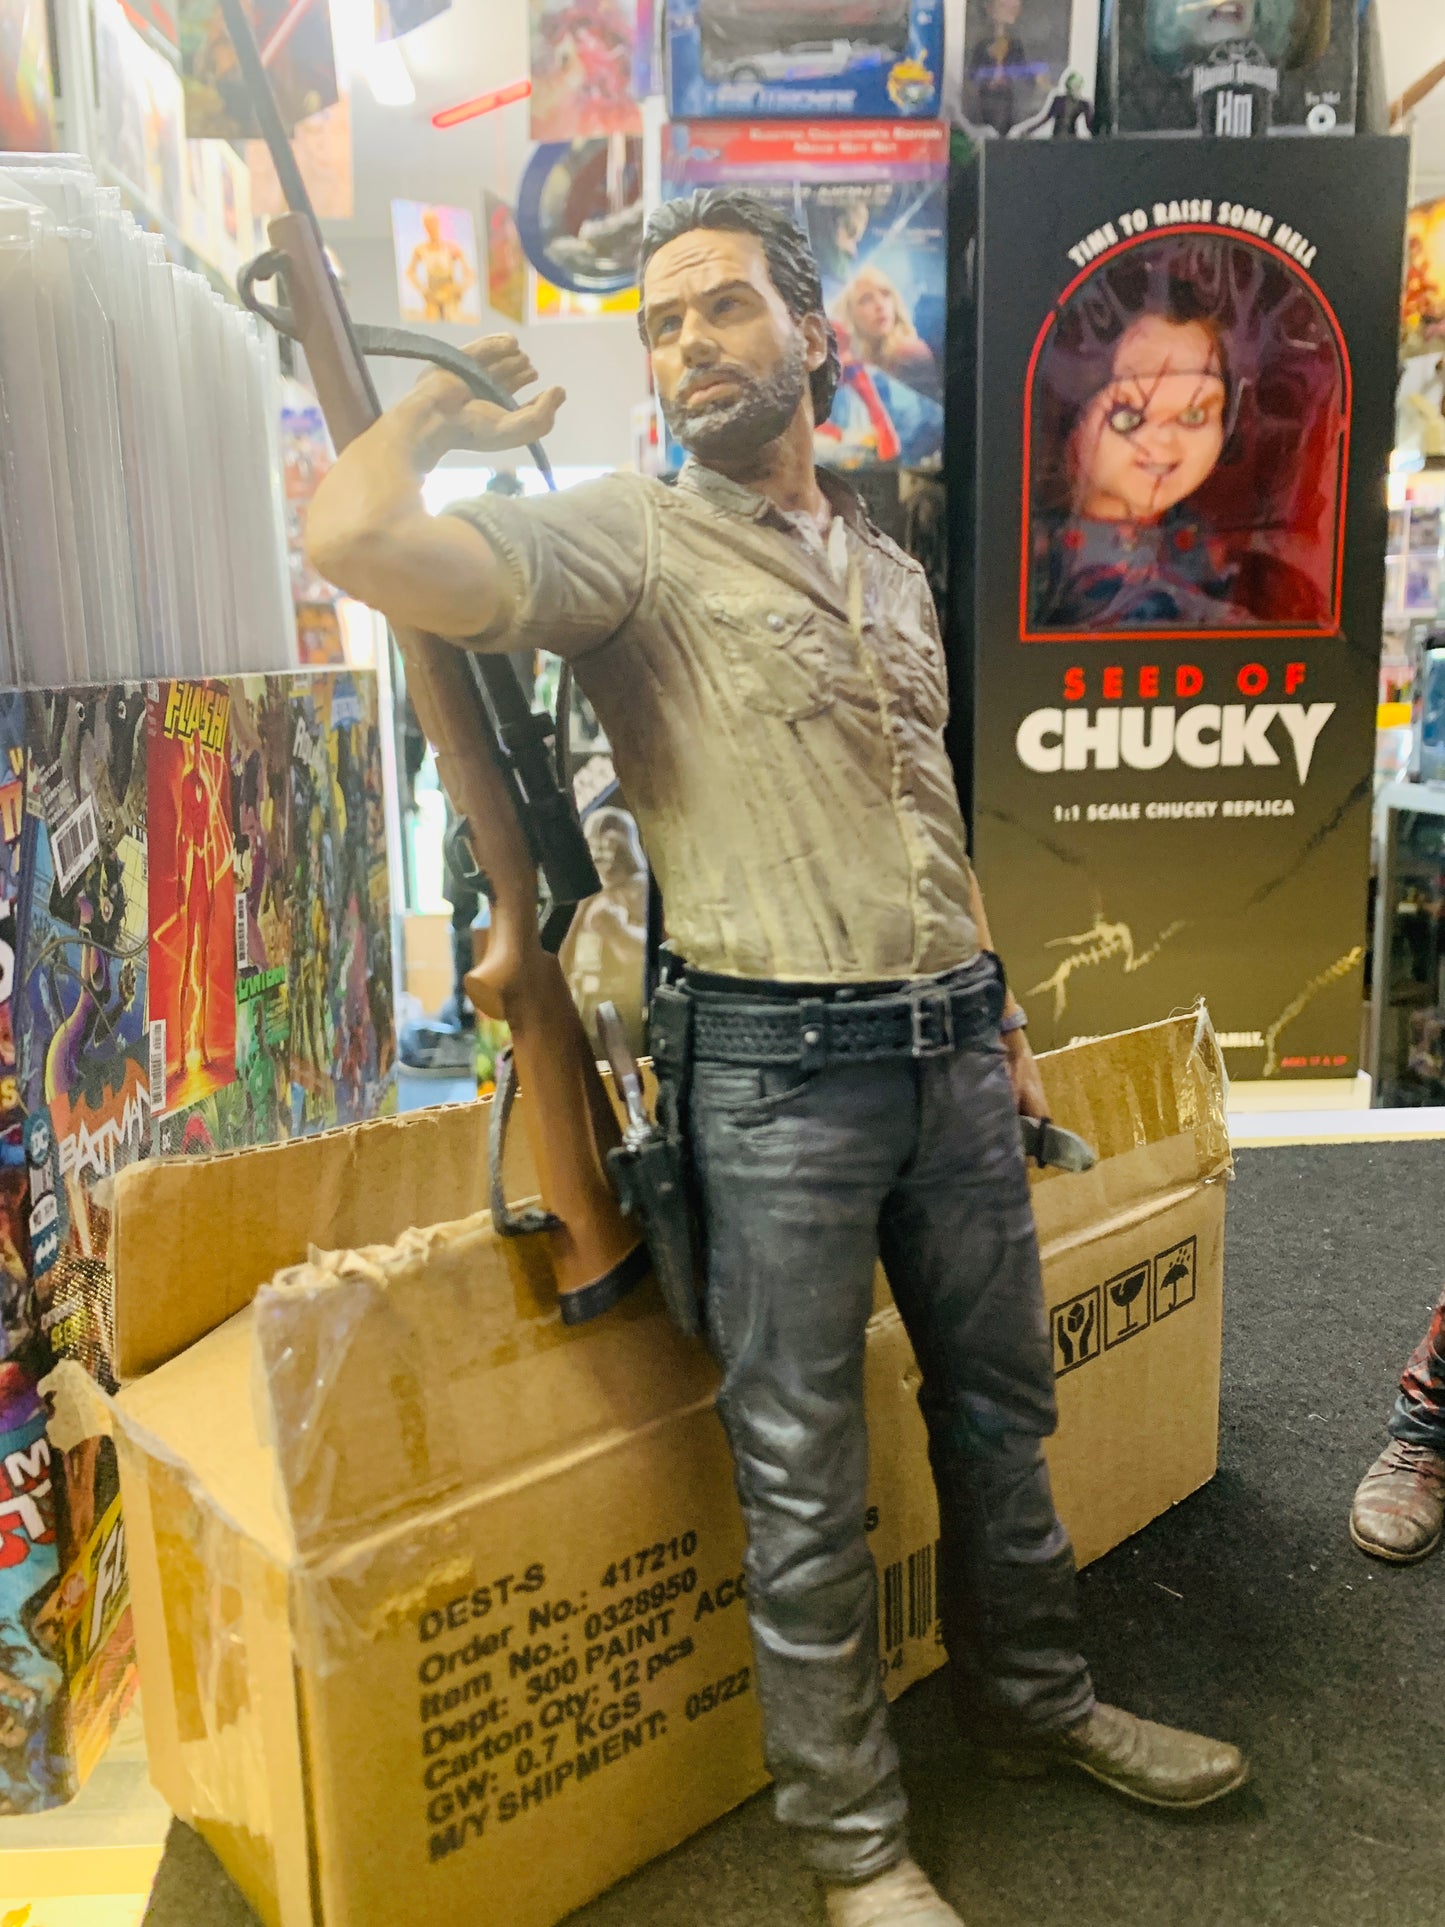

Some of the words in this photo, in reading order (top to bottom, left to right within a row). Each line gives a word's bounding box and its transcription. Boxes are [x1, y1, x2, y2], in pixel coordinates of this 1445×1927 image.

[1067, 221, 1119, 268] TIME
[1118, 208, 1148, 236] TO
[1152, 199, 1213, 227] RAISE
[1216, 201, 1274, 238] SOME
[1272, 223, 1318, 269] HELL
[1064, 665, 1204, 701] SEED
[1236, 662, 1307, 697] OF
[1016, 702, 1337, 786] CHUCKY
[1053, 804, 1081, 822] 1:1
[1086, 802, 1142, 822] SCALE
[1145, 800, 1219, 820] CHUCKY
[1222, 799, 1296, 818] REPLICA
[59, 1080, 151, 1186] BATMAN
[418, 1562, 546, 1642] DEST-S
[418, 1624, 514, 1685] Order
[528, 1590, 588, 1636] No.:
[602, 1529, 698, 1588] 417210
[420, 1670, 493, 1723] Item
[508, 1632, 571, 1679] No.:
[584, 1566, 698, 1641] 0328950
[422, 1697, 509, 1757] Dept:
[585, 1608, 675, 1675] PAINT
[423, 1719, 534, 1791] Carton
[539, 1683, 599, 1729] Qty:
[608, 1659, 641, 1692] 12
[646, 1635, 694, 1681] pcs
[427, 1770, 499, 1825] GW:
[514, 1732, 559, 1777] 0.7
[576, 1690, 641, 1746] KGS
[429, 1803, 490, 1864] M/Y
